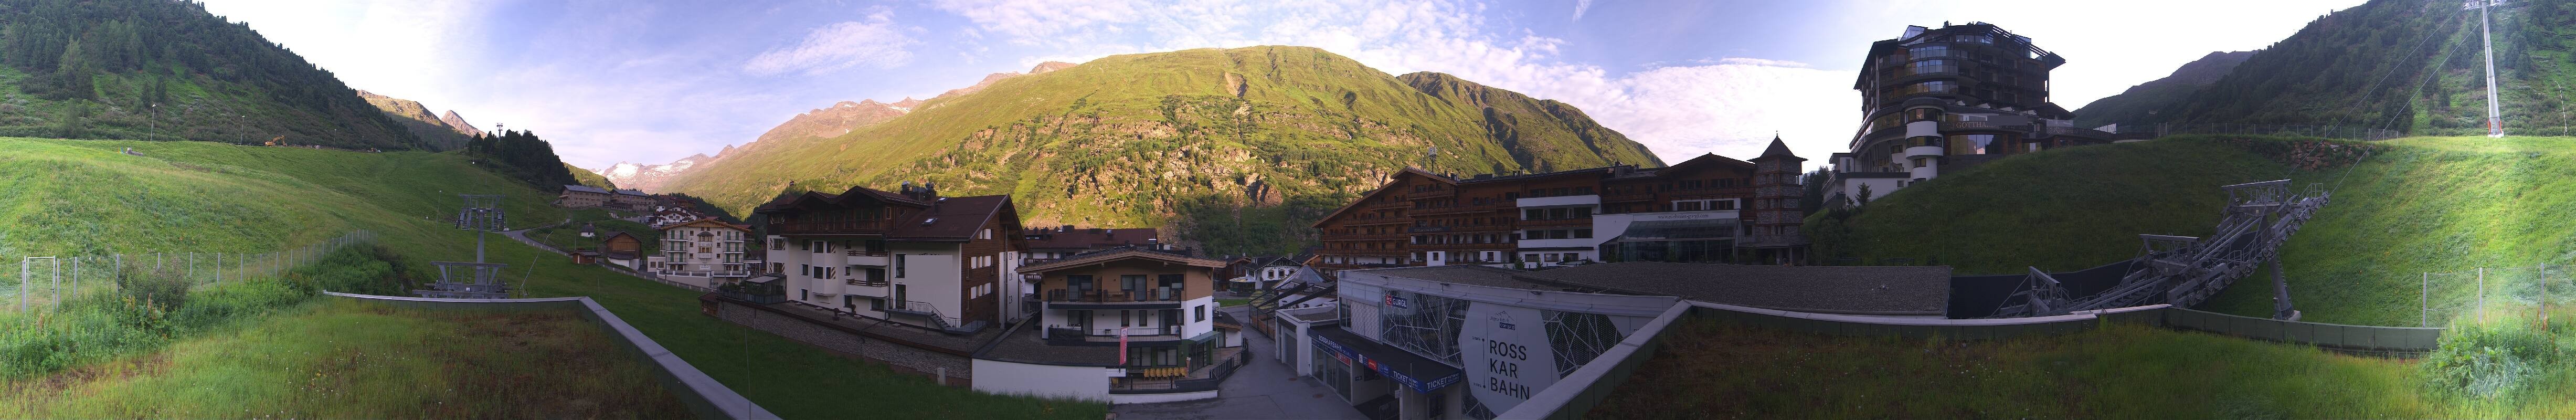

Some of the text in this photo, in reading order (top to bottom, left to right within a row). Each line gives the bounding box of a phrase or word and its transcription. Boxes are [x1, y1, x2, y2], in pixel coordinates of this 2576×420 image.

[1393, 298, 1406, 307] GURGL
[1319, 334, 1342, 352] ROSSKARBAHN
[1490, 340, 1526, 361] ROSS
[1394, 371, 1408, 383] TICKET
[1490, 358, 1518, 379] KAR
[1427, 377, 1447, 390] TICKET
[1491, 377, 1530, 400] BAHN
